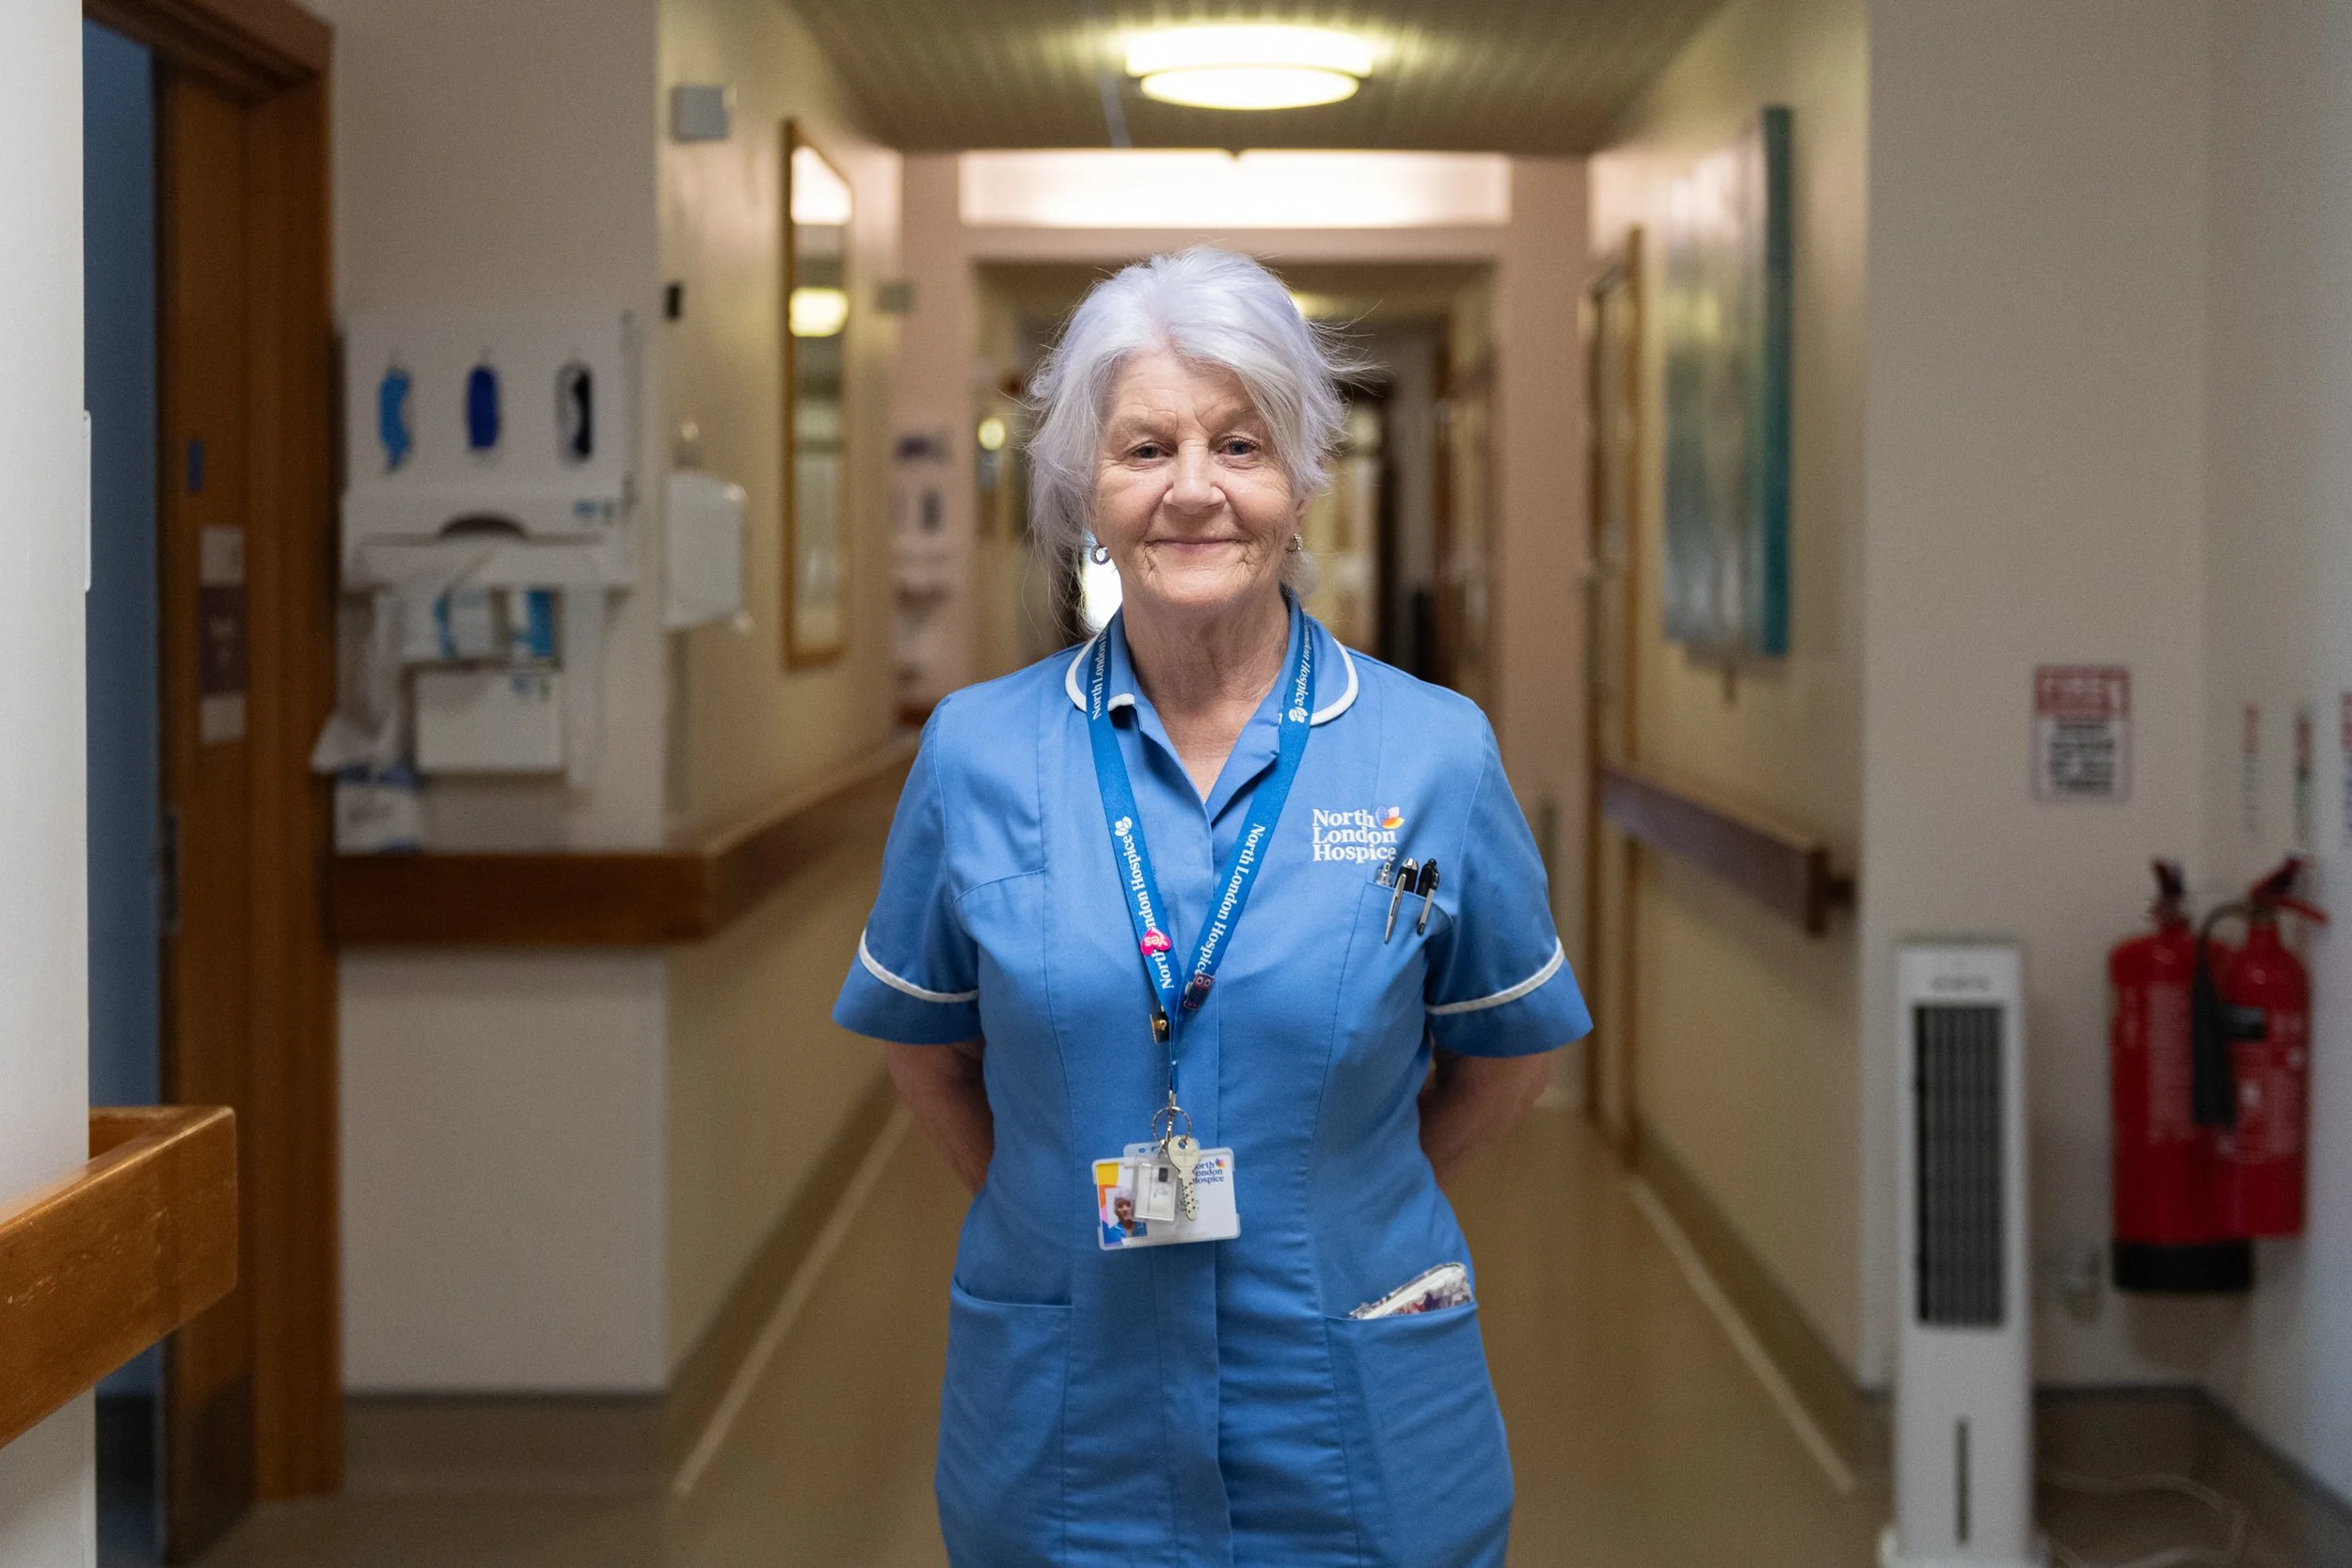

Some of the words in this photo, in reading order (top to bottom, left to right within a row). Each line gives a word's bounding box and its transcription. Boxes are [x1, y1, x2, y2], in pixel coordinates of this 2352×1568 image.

[1092, 641, 1107, 684] London
[1091, 682, 1103, 721] North
[1295, 659, 1311, 706] Hospice
[1311, 808, 1376, 828] North
[1311, 826, 1397, 844] London
[1239, 823, 1266, 864] North
[1311, 843, 1398, 864] Hospice
[1122, 834, 1146, 892] Hospice
[1137, 890, 1157, 928] ndon
[1216, 863, 1250, 920] London
[1143, 934, 1169, 948] Yes
[1196, 1161, 1215, 1169] orth
[1196, 1168, 1223, 1177] ondon
